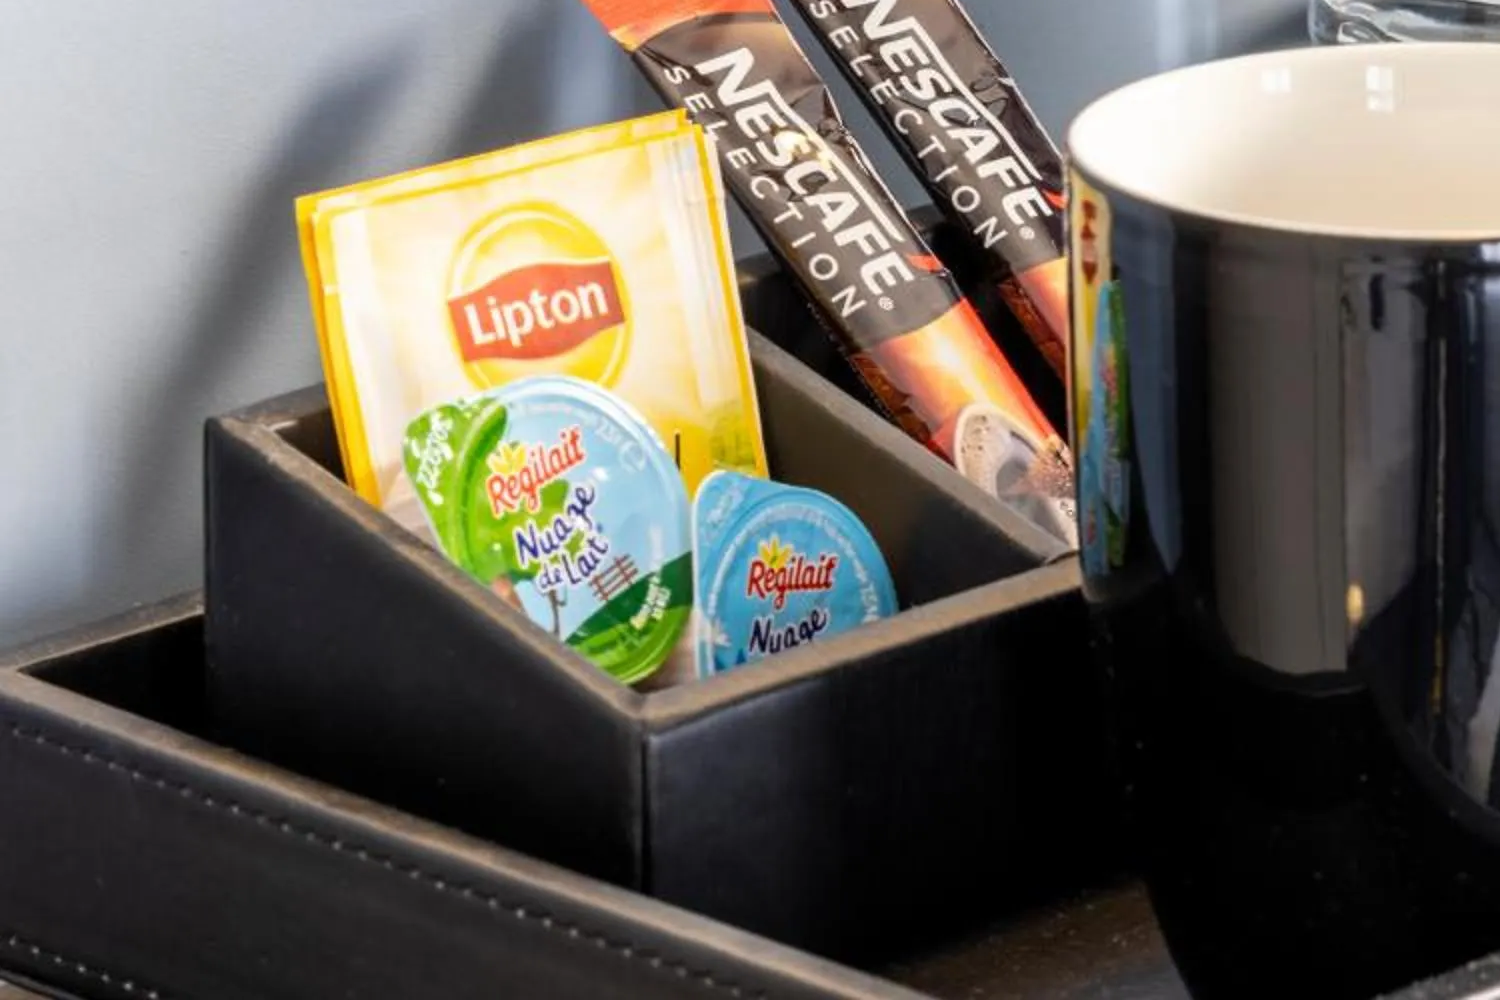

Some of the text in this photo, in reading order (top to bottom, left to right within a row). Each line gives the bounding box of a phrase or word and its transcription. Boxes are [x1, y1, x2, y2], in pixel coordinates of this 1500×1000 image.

[809, 0, 1008, 249] SELECTION
[664, 65, 867, 318] SELECTION
[463, 280, 609, 348] Lipton
[515, 484, 596, 565] Nuage
[539, 523, 609, 589] de Lait
[748, 608, 828, 655] Nuage
